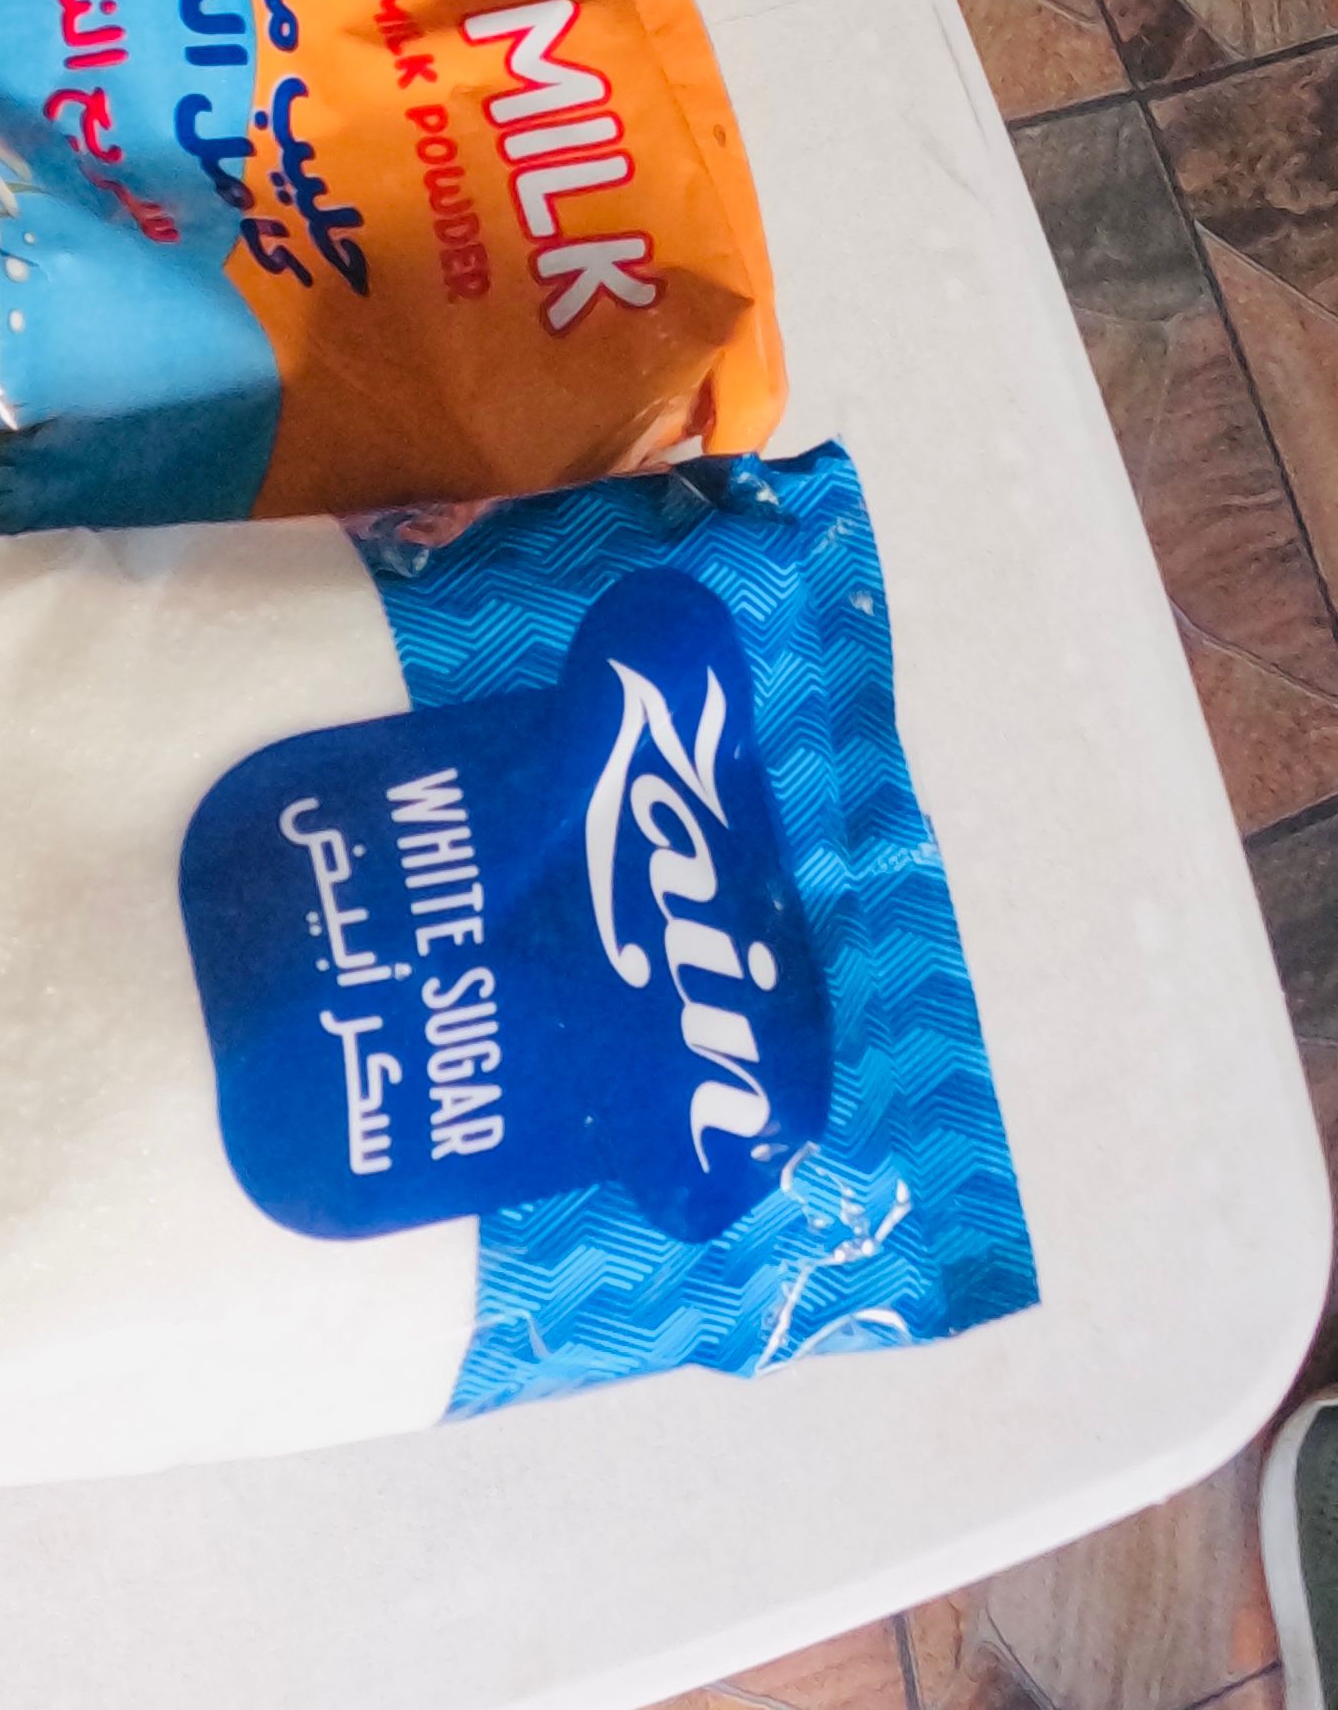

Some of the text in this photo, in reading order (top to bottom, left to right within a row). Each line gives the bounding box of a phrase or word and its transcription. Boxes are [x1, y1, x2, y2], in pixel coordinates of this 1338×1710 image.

[173, 91, 314, 289] كامل
[254, 75, 370, 297] حليب
[403, 103, 494, 306] POWDER
[278, 795, 414, 1177] سكر أبيض
[386, 765, 505, 1162] WHITE SUGAR
[585, 657, 778, 1174] Zain
